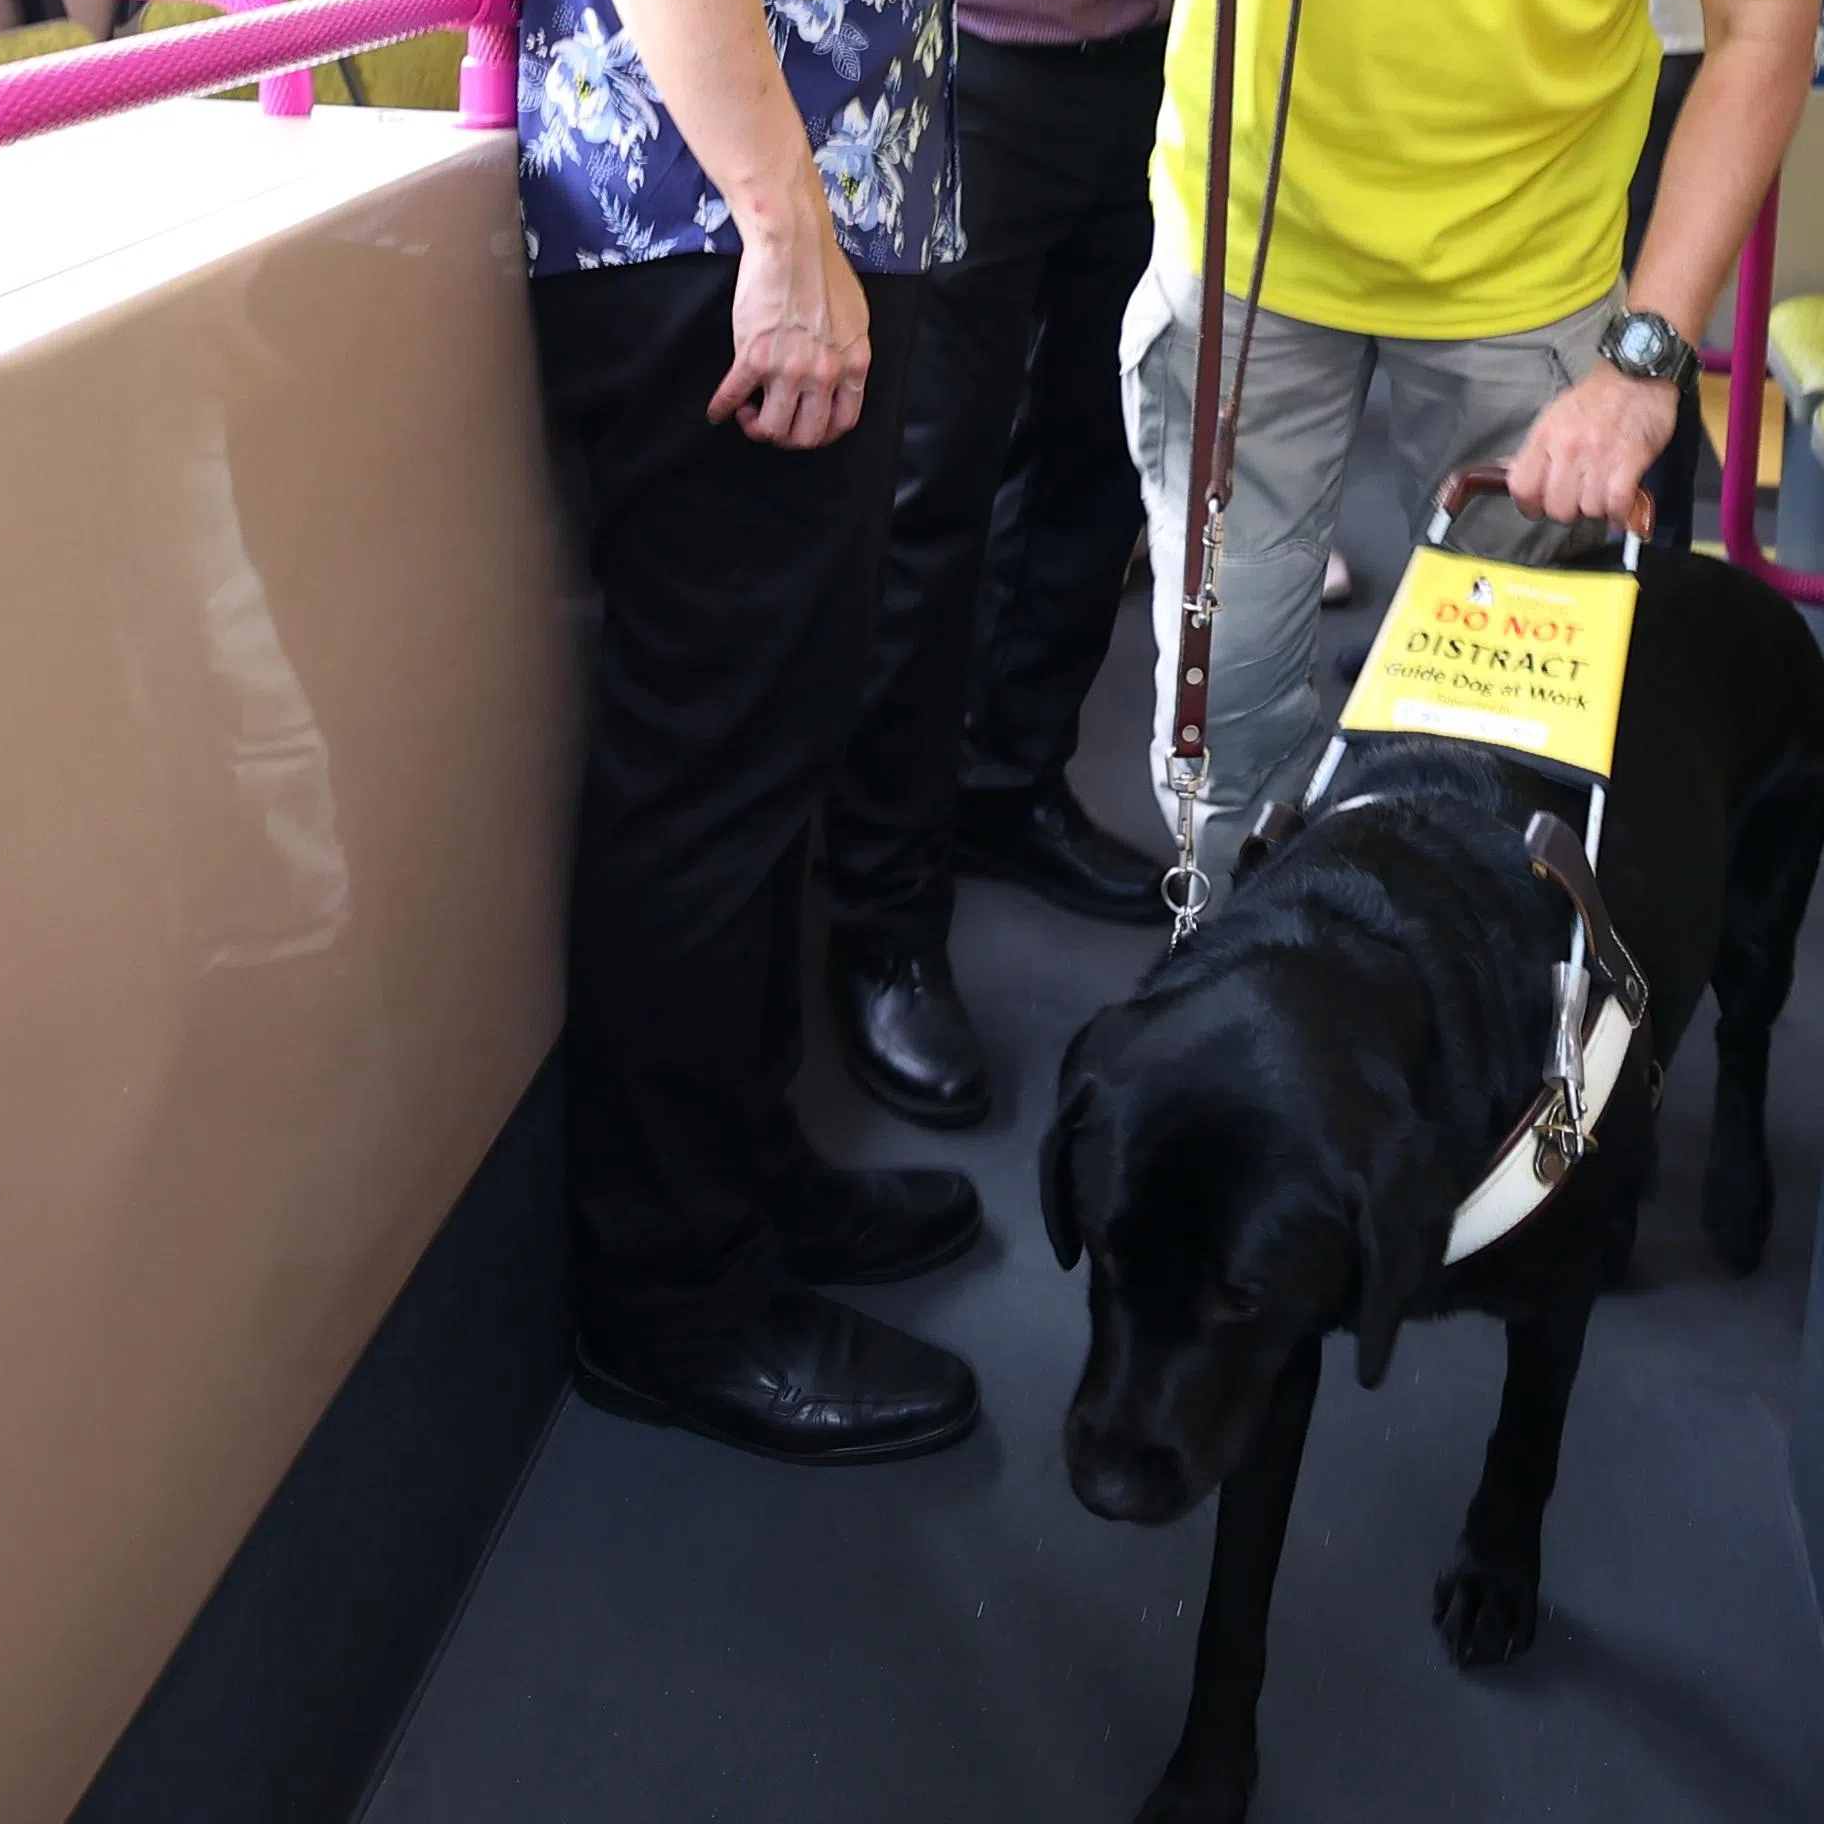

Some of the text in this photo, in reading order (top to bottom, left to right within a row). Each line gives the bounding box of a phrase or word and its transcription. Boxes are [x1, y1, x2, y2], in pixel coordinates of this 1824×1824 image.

[1434, 597, 1489, 632] DO
[1503, 614, 1585, 645] NOT
[1405, 631, 1590, 683] DISTRACT
[1384, 662, 1591, 711] Guide Dog at Work
